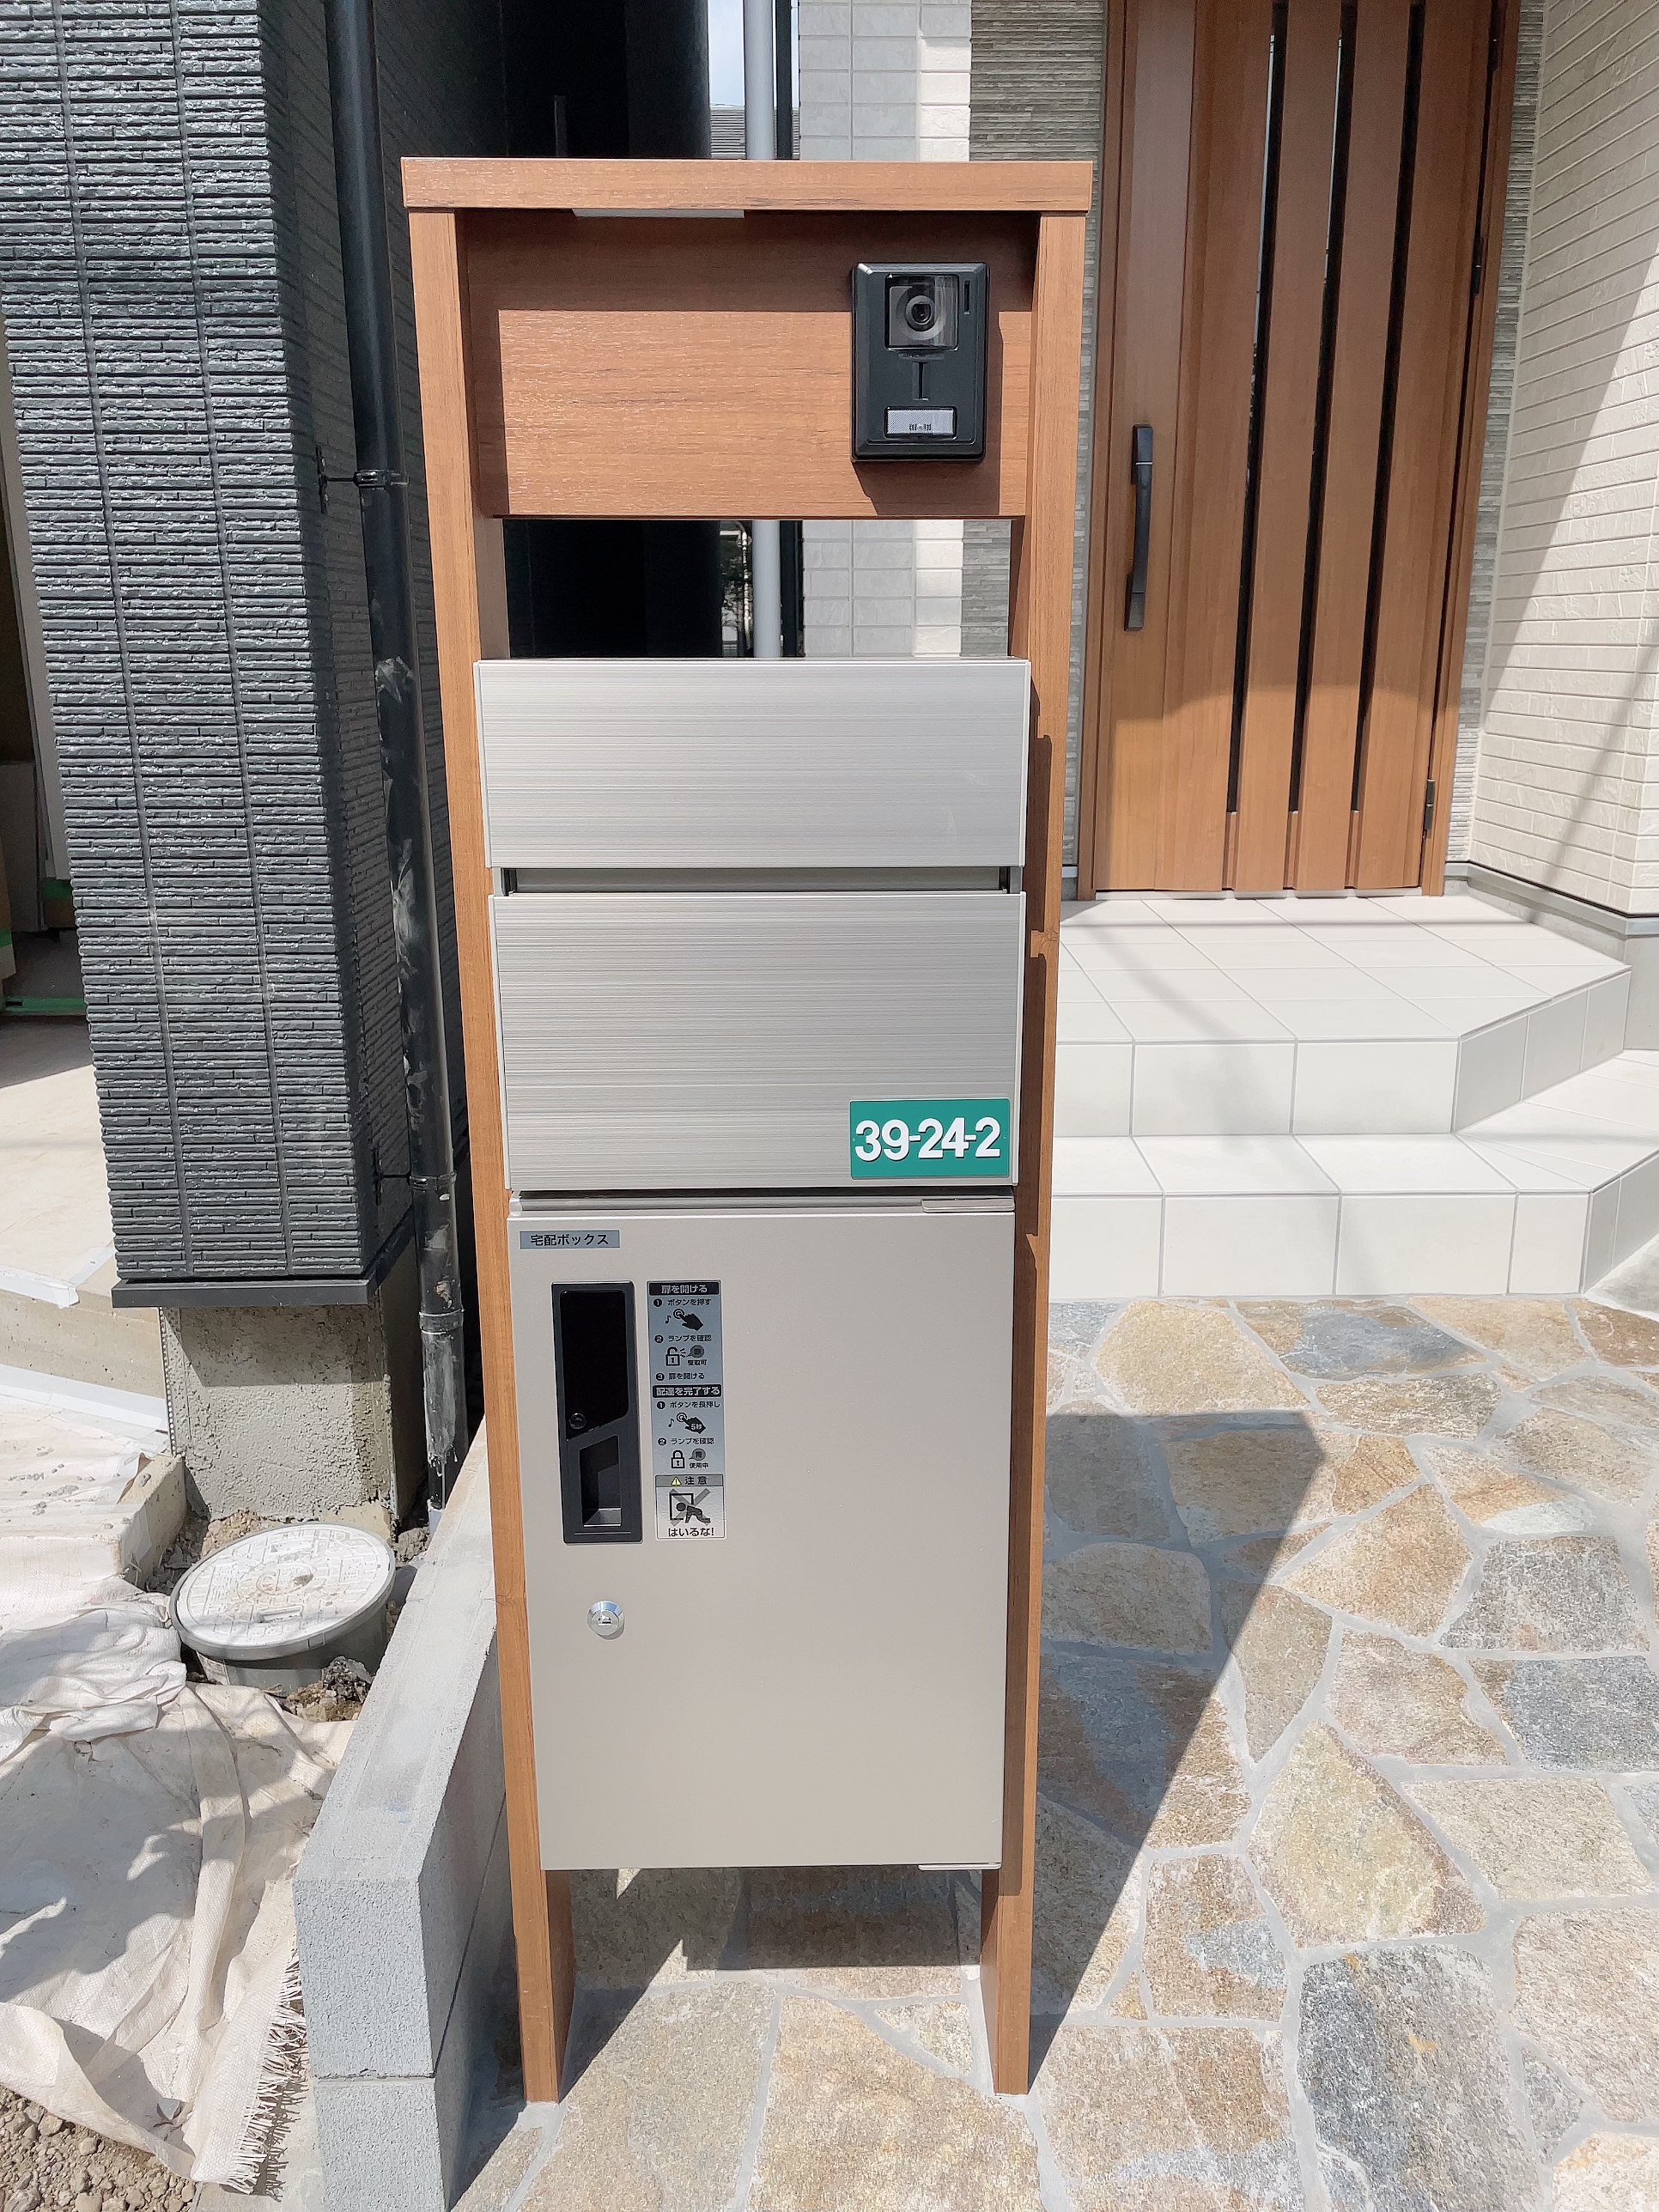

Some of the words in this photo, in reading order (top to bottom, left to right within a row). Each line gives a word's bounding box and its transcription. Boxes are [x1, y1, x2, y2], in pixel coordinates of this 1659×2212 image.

[854, 1116, 1001, 1162] 39-24-2
[530, 1233, 609, 1246] 宅配ボックス
[660, 1284, 708, 1294] 扉を開ける
[668, 1528, 714, 1537] はいるな!
